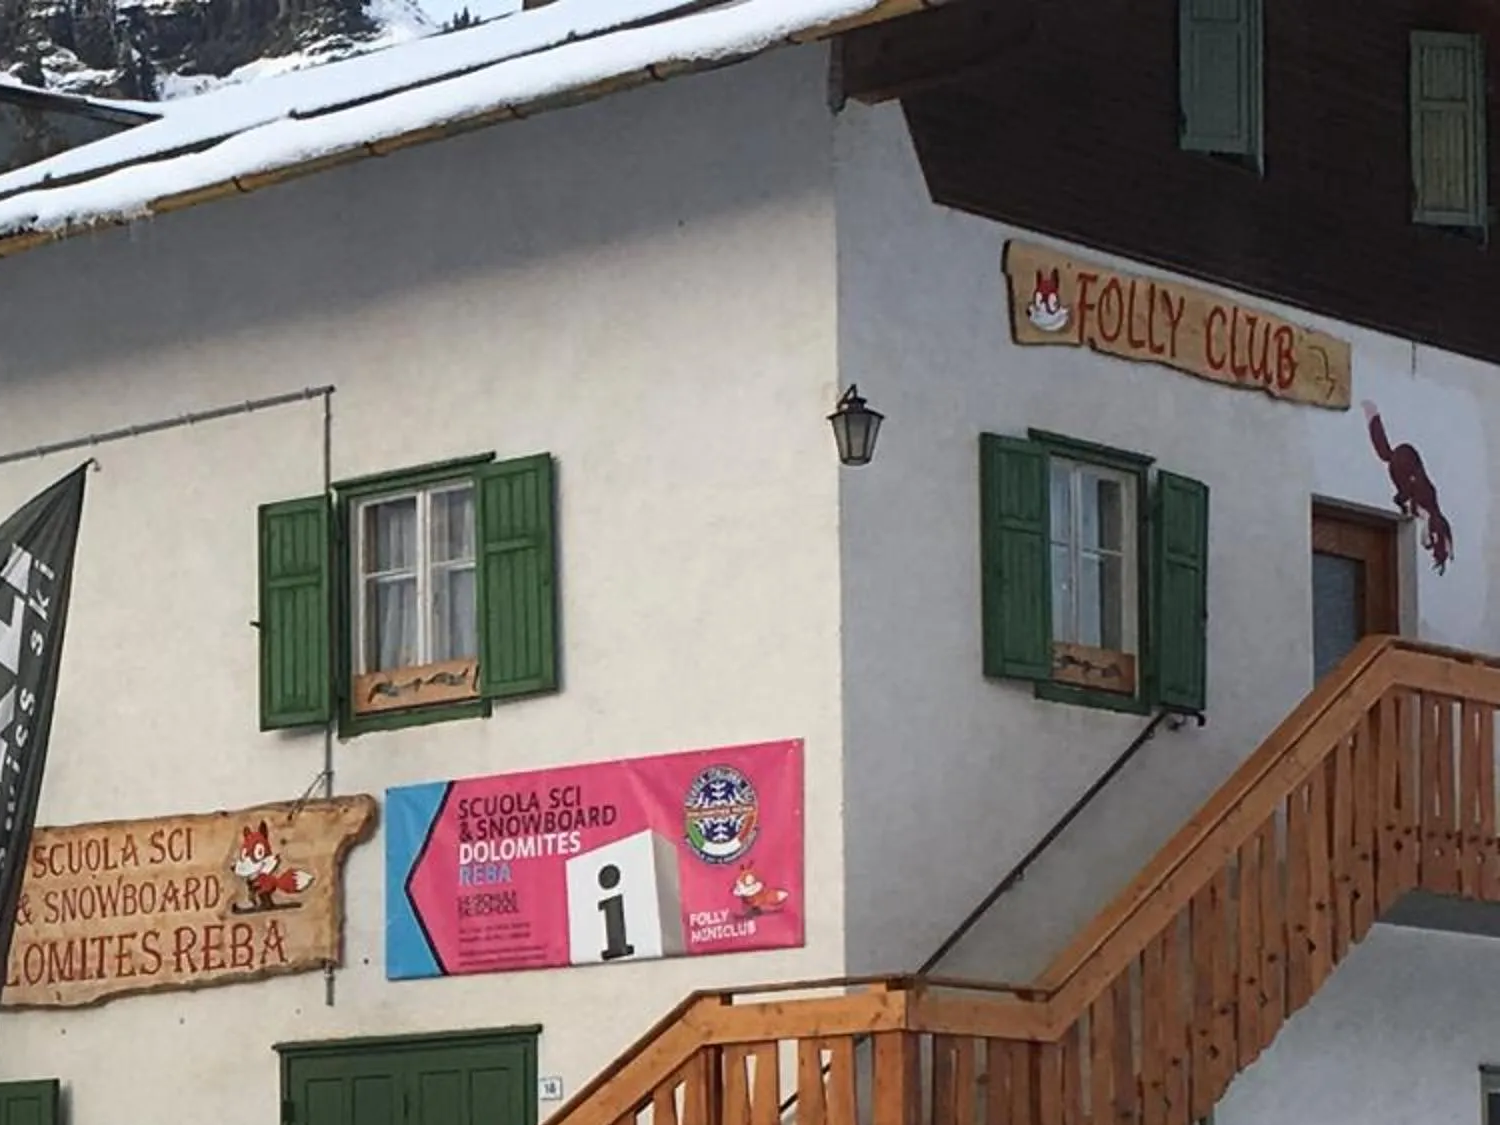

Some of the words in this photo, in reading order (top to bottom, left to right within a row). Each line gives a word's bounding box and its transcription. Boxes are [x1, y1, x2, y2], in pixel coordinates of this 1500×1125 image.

[1077, 272, 1185, 357] FOLLY
[1205, 305, 1298, 389] CLUB
[28, 559, 56, 657] ski
[459, 792, 540, 820] SCUOLA
[549, 786, 582, 809] SCI
[32, 834, 140, 879] SCUOLA
[149, 828, 194, 863] SCI
[459, 832, 581, 865] DOLOMITES
[44, 875, 221, 925] SNOWBOARD
[459, 863, 512, 887] REBA
[689, 908, 730, 927] FOLLY
[173, 919, 289, 974] REBA
